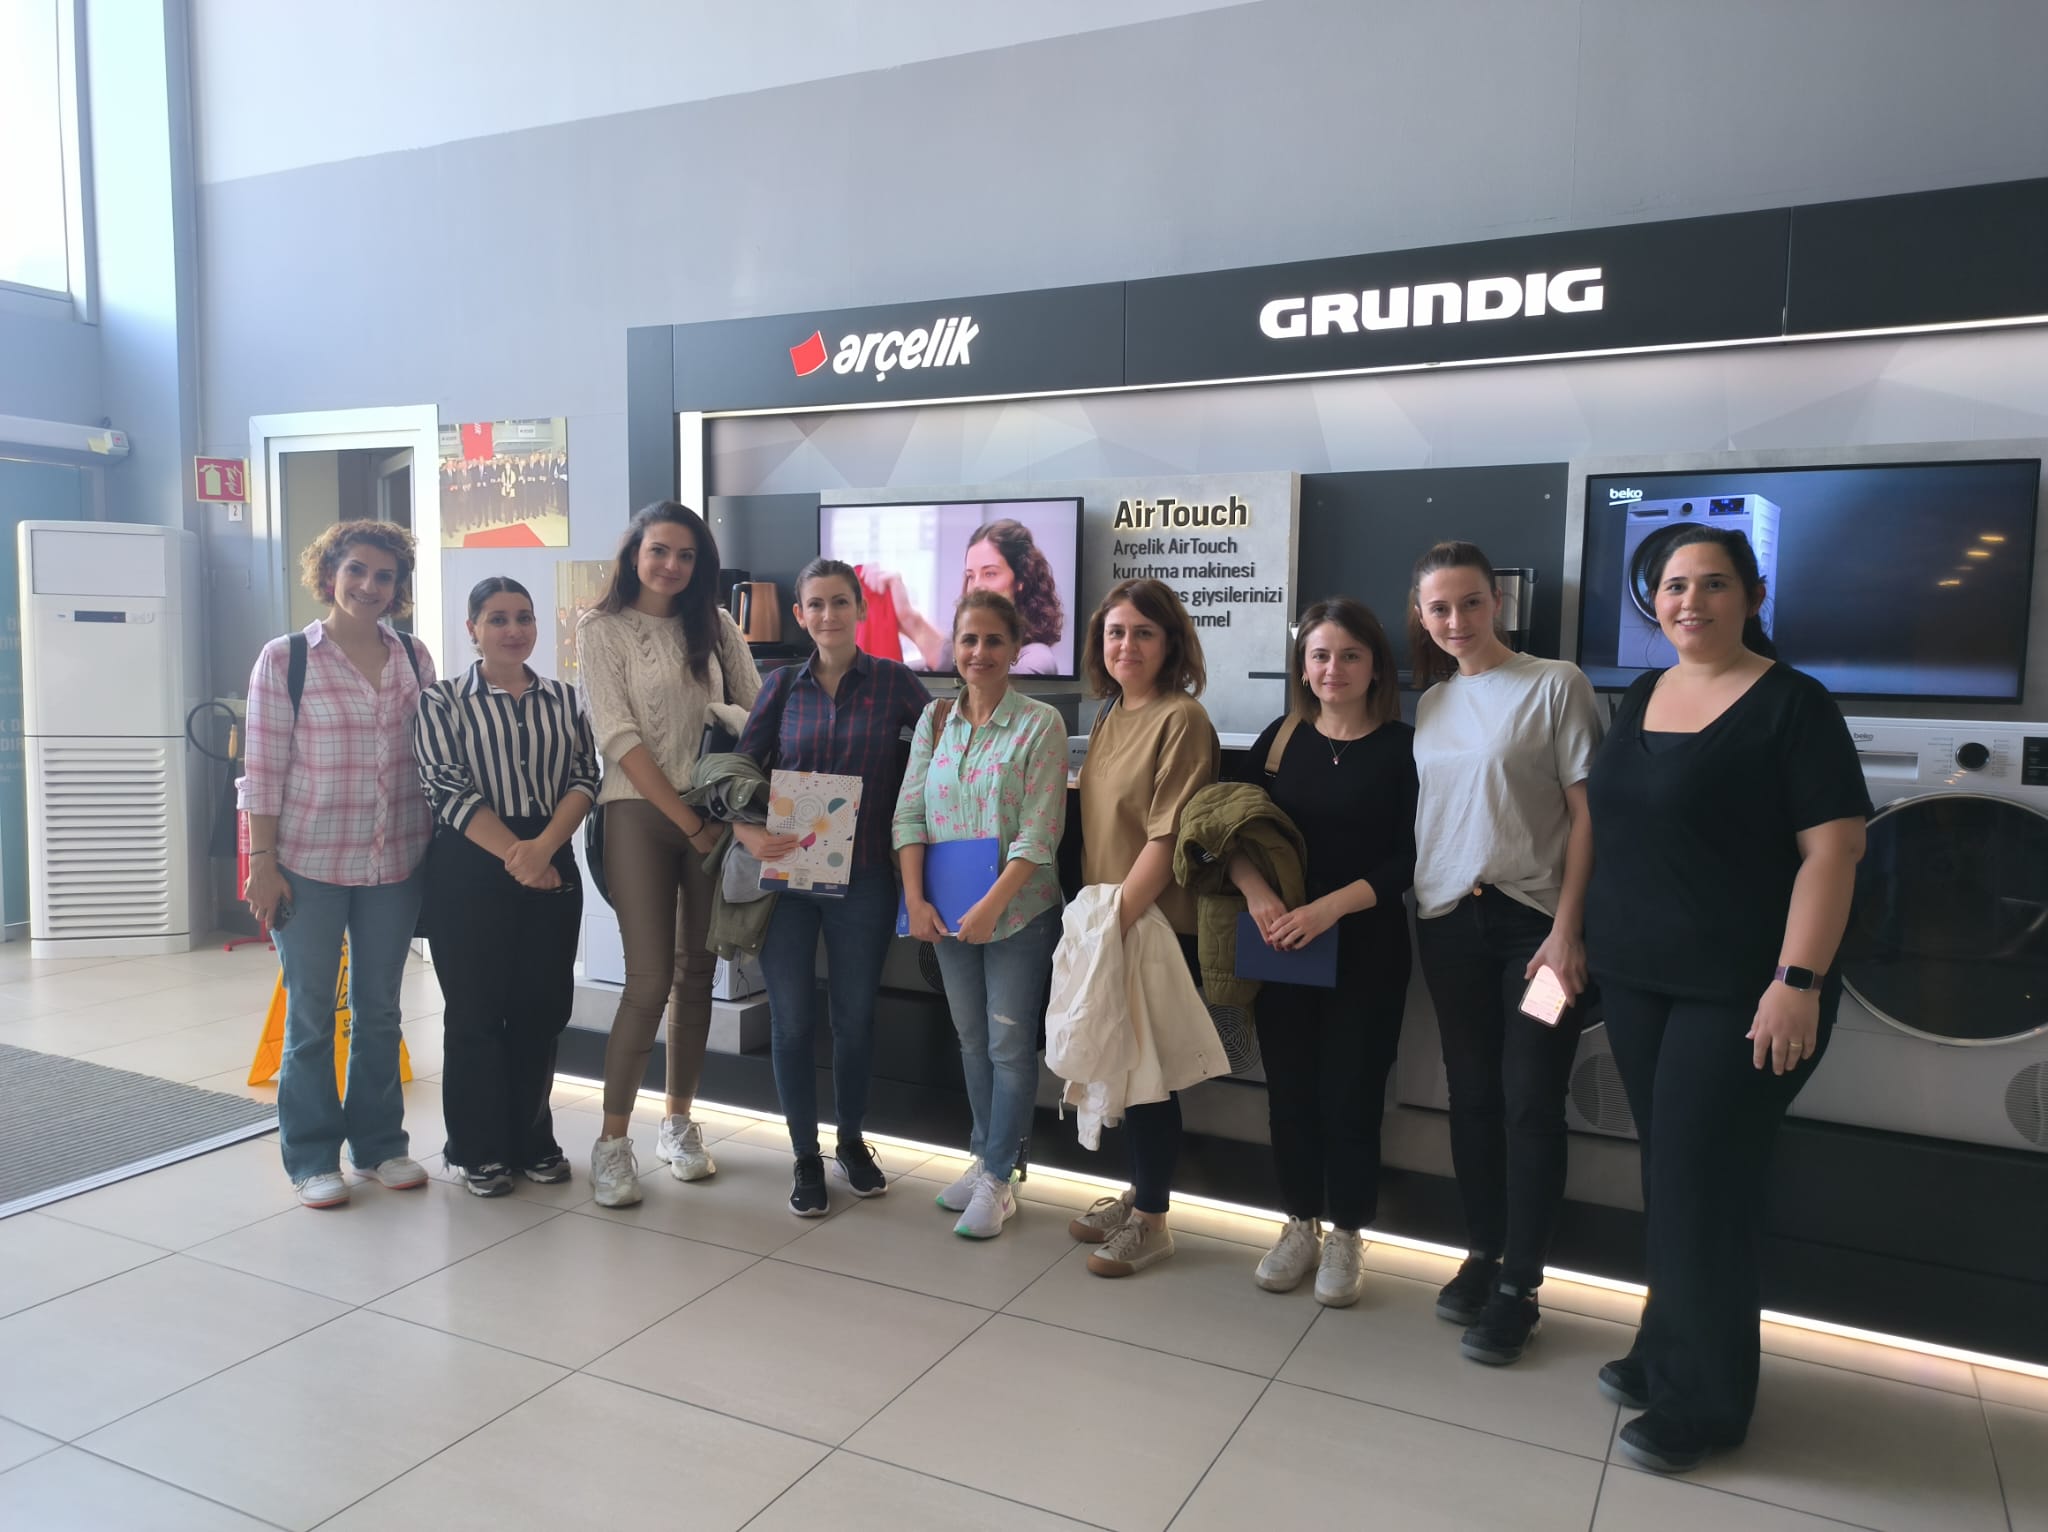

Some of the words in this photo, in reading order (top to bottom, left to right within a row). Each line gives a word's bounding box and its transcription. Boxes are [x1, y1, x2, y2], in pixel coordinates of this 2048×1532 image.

[1259, 266, 1604, 339] GRUNDIG
[832, 316, 980, 383] arçelik
[1609, 487, 1643, 500] beko
[1113, 495, 1248, 529] AirTouch
[1113, 538, 1165, 559] Arçelik
[1168, 536, 1238, 555] AirTouch
[1112, 563, 1179, 580] kurutma
[1182, 561, 1256, 579] makinesi
[1192, 586, 1283, 607] giysilerinizi
[1189, 610, 1231, 628] mmel
